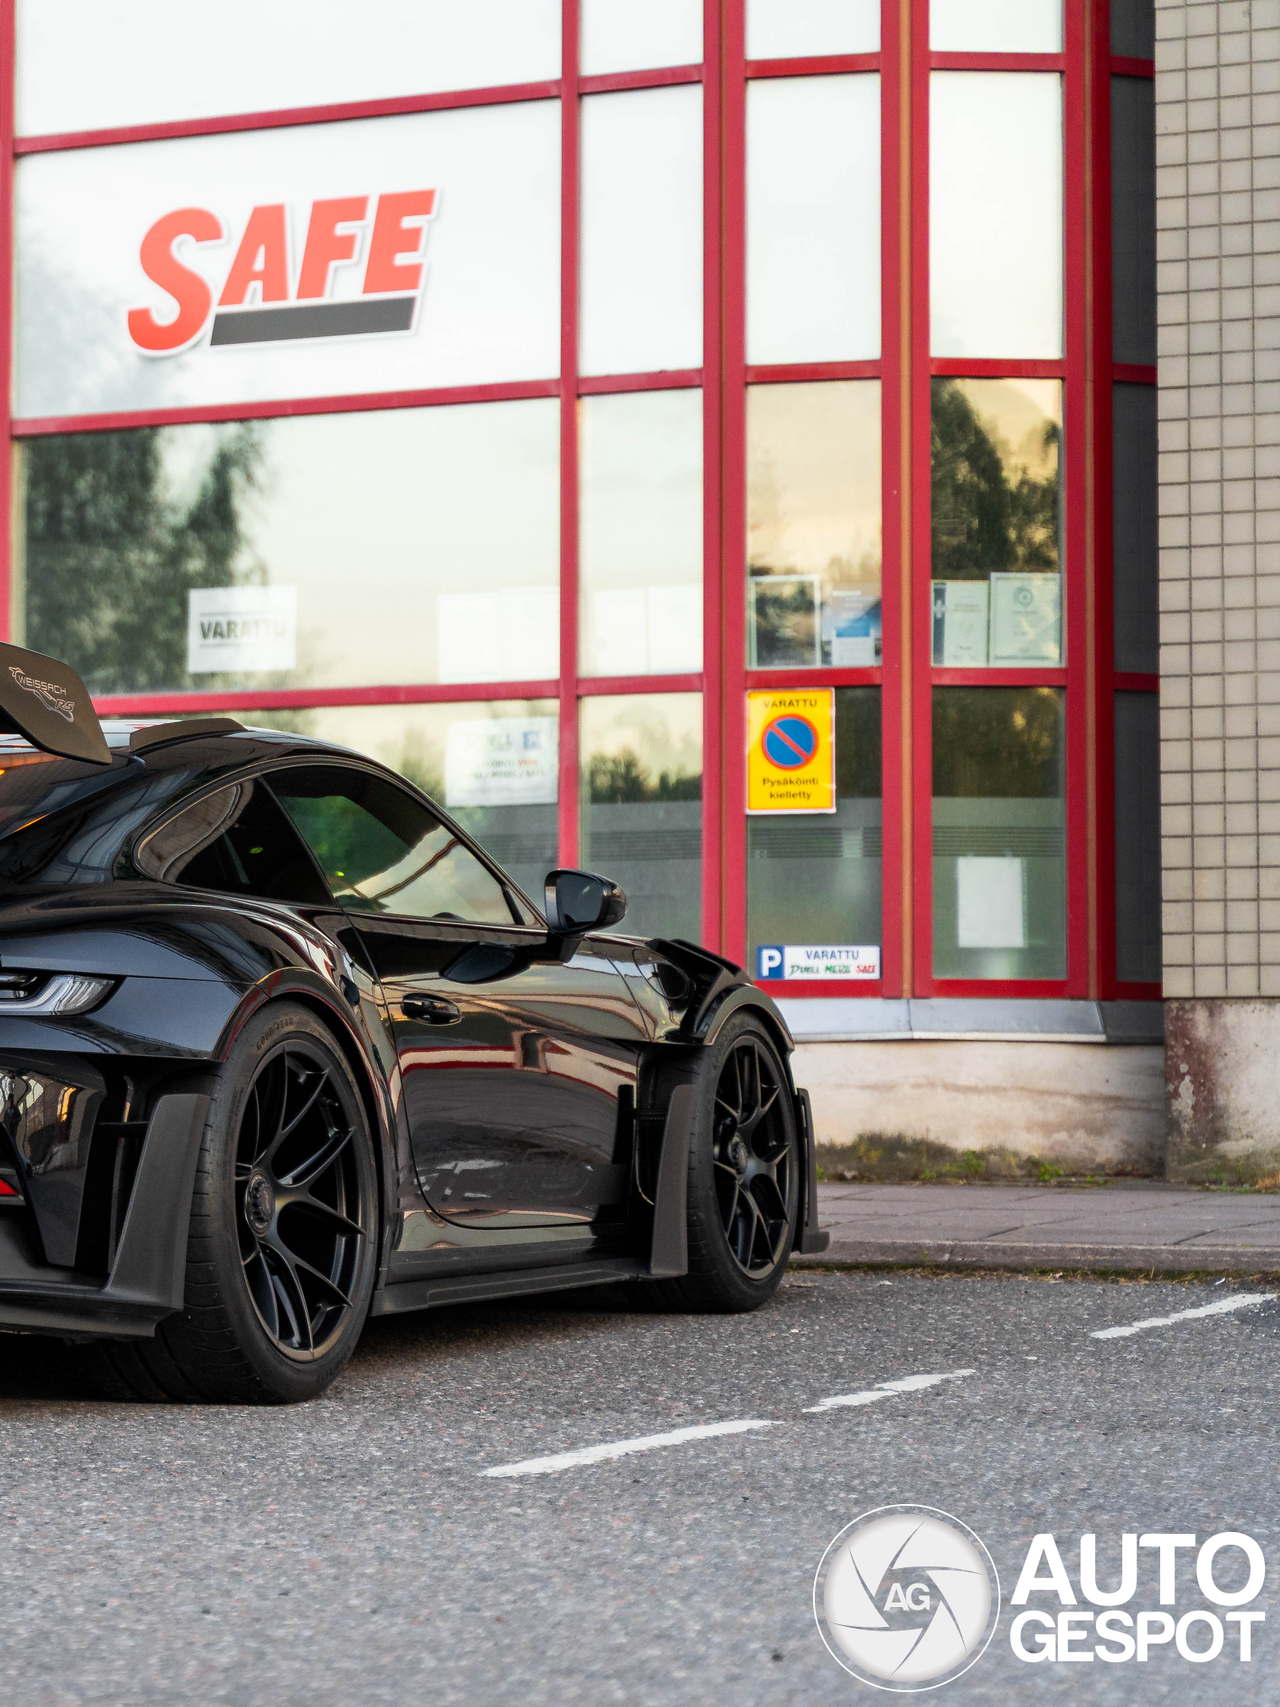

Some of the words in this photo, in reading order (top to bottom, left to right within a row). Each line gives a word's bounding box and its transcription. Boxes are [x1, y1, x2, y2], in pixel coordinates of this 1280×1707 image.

[128, 188, 436, 351] SAFE
[200, 620, 286, 640] VARATTU
[18, 675, 67, 696] WEISSACH
[764, 698, 817, 708] VARATTU
[763, 777, 819, 788] Pysäköinti
[770, 791, 812, 802] kielletty
[806, 950, 859, 960] VARATTU
[762, 949, 782, 977] P
